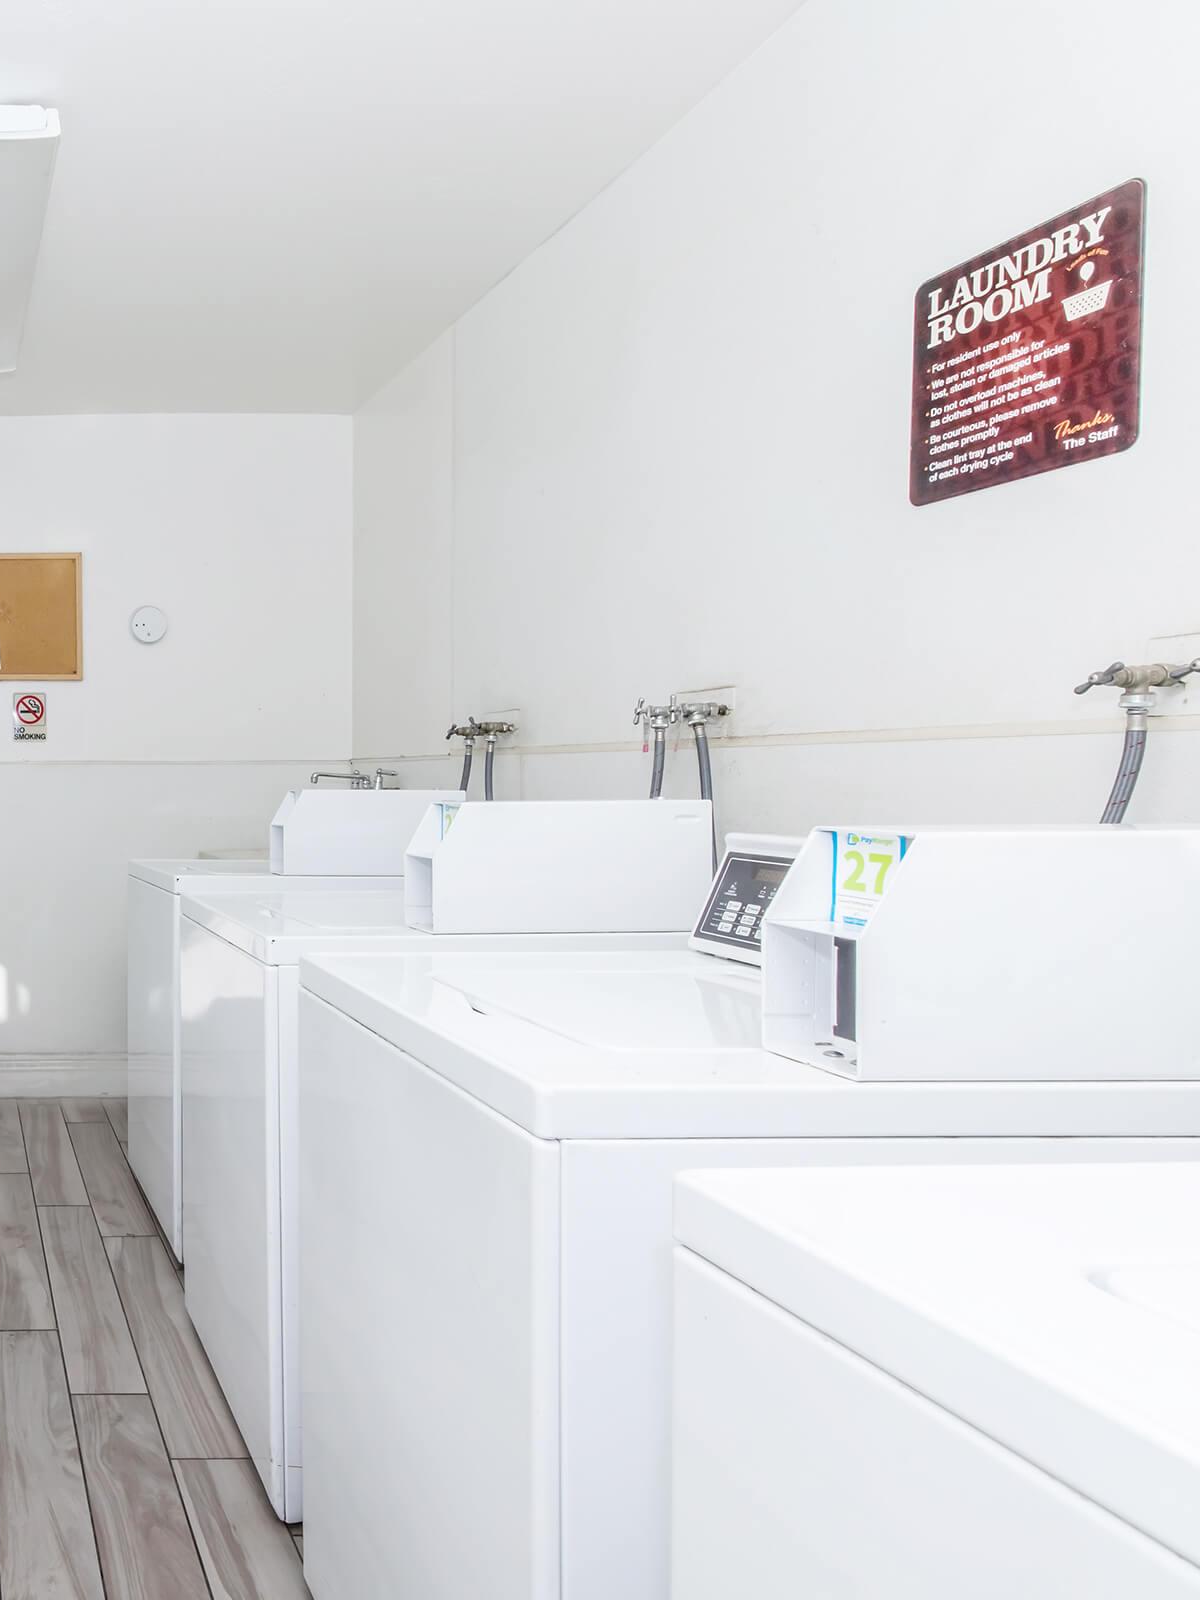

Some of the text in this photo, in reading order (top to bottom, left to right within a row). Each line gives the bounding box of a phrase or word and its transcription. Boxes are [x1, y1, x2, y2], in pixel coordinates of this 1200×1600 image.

[927, 206, 1112, 320] LAUNDRY
[926, 267, 1053, 349] ROOM
[931, 331, 1021, 374] For resident use only
[931, 339, 1046, 390] We are not responsible for
[931, 342, 1070, 401] lost, stolen or damaged articles
[930, 370, 1046, 417] Do not overload machines,
[930, 376, 1061, 428] as clothes will not be as clean
[929, 396, 1057, 444] Be courteous, please remove
[929, 426, 1000, 455] clothes promptly
[1053, 410, 1115, 440] Thanks,
[1063, 425, 1119, 450] The Staff
[929, 431, 1032, 472] Clean lint tray at the end
[929, 451, 1014, 482] of each drying cycle
[843, 850, 893, 896] 27
